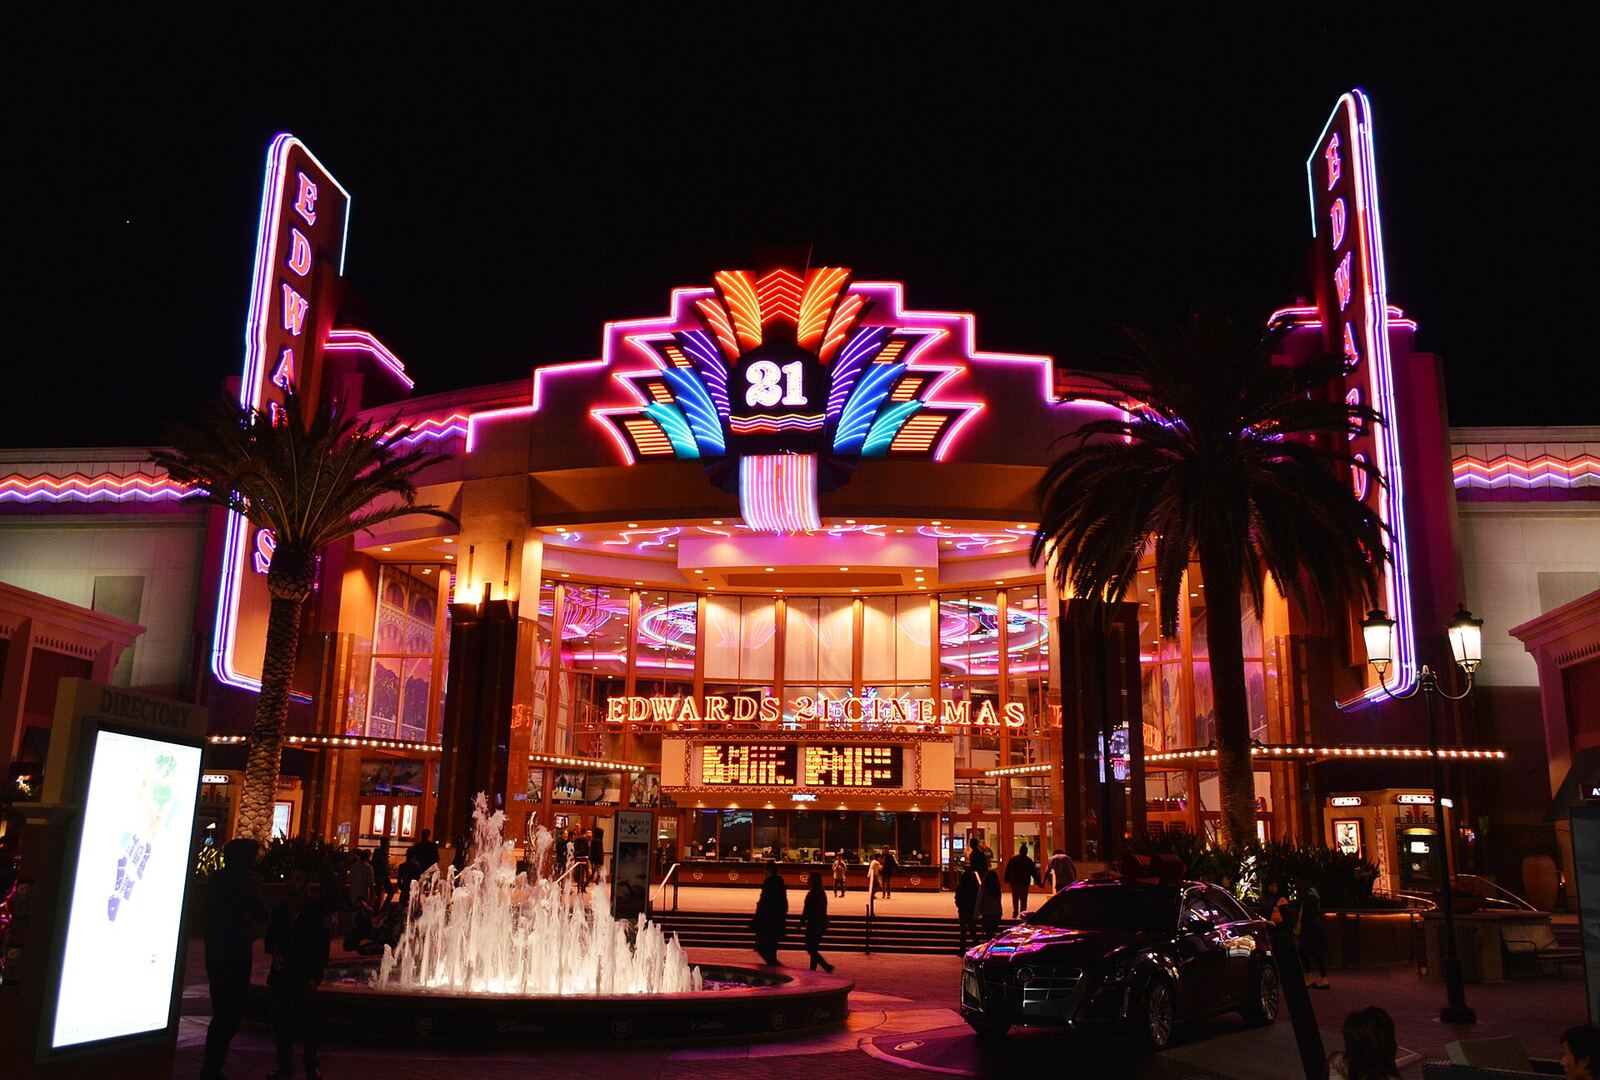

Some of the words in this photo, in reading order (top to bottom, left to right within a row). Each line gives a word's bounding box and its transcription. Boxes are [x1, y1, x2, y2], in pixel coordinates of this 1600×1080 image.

[745, 360, 808, 407] 21
[99, 688, 192, 728] DIRECTORY
[606, 695, 780, 723] EDWARDS
[795, 695, 834, 722] 21
[844, 697, 1026, 727] CINEMAS
[620, 818, 650, 826] Modern
